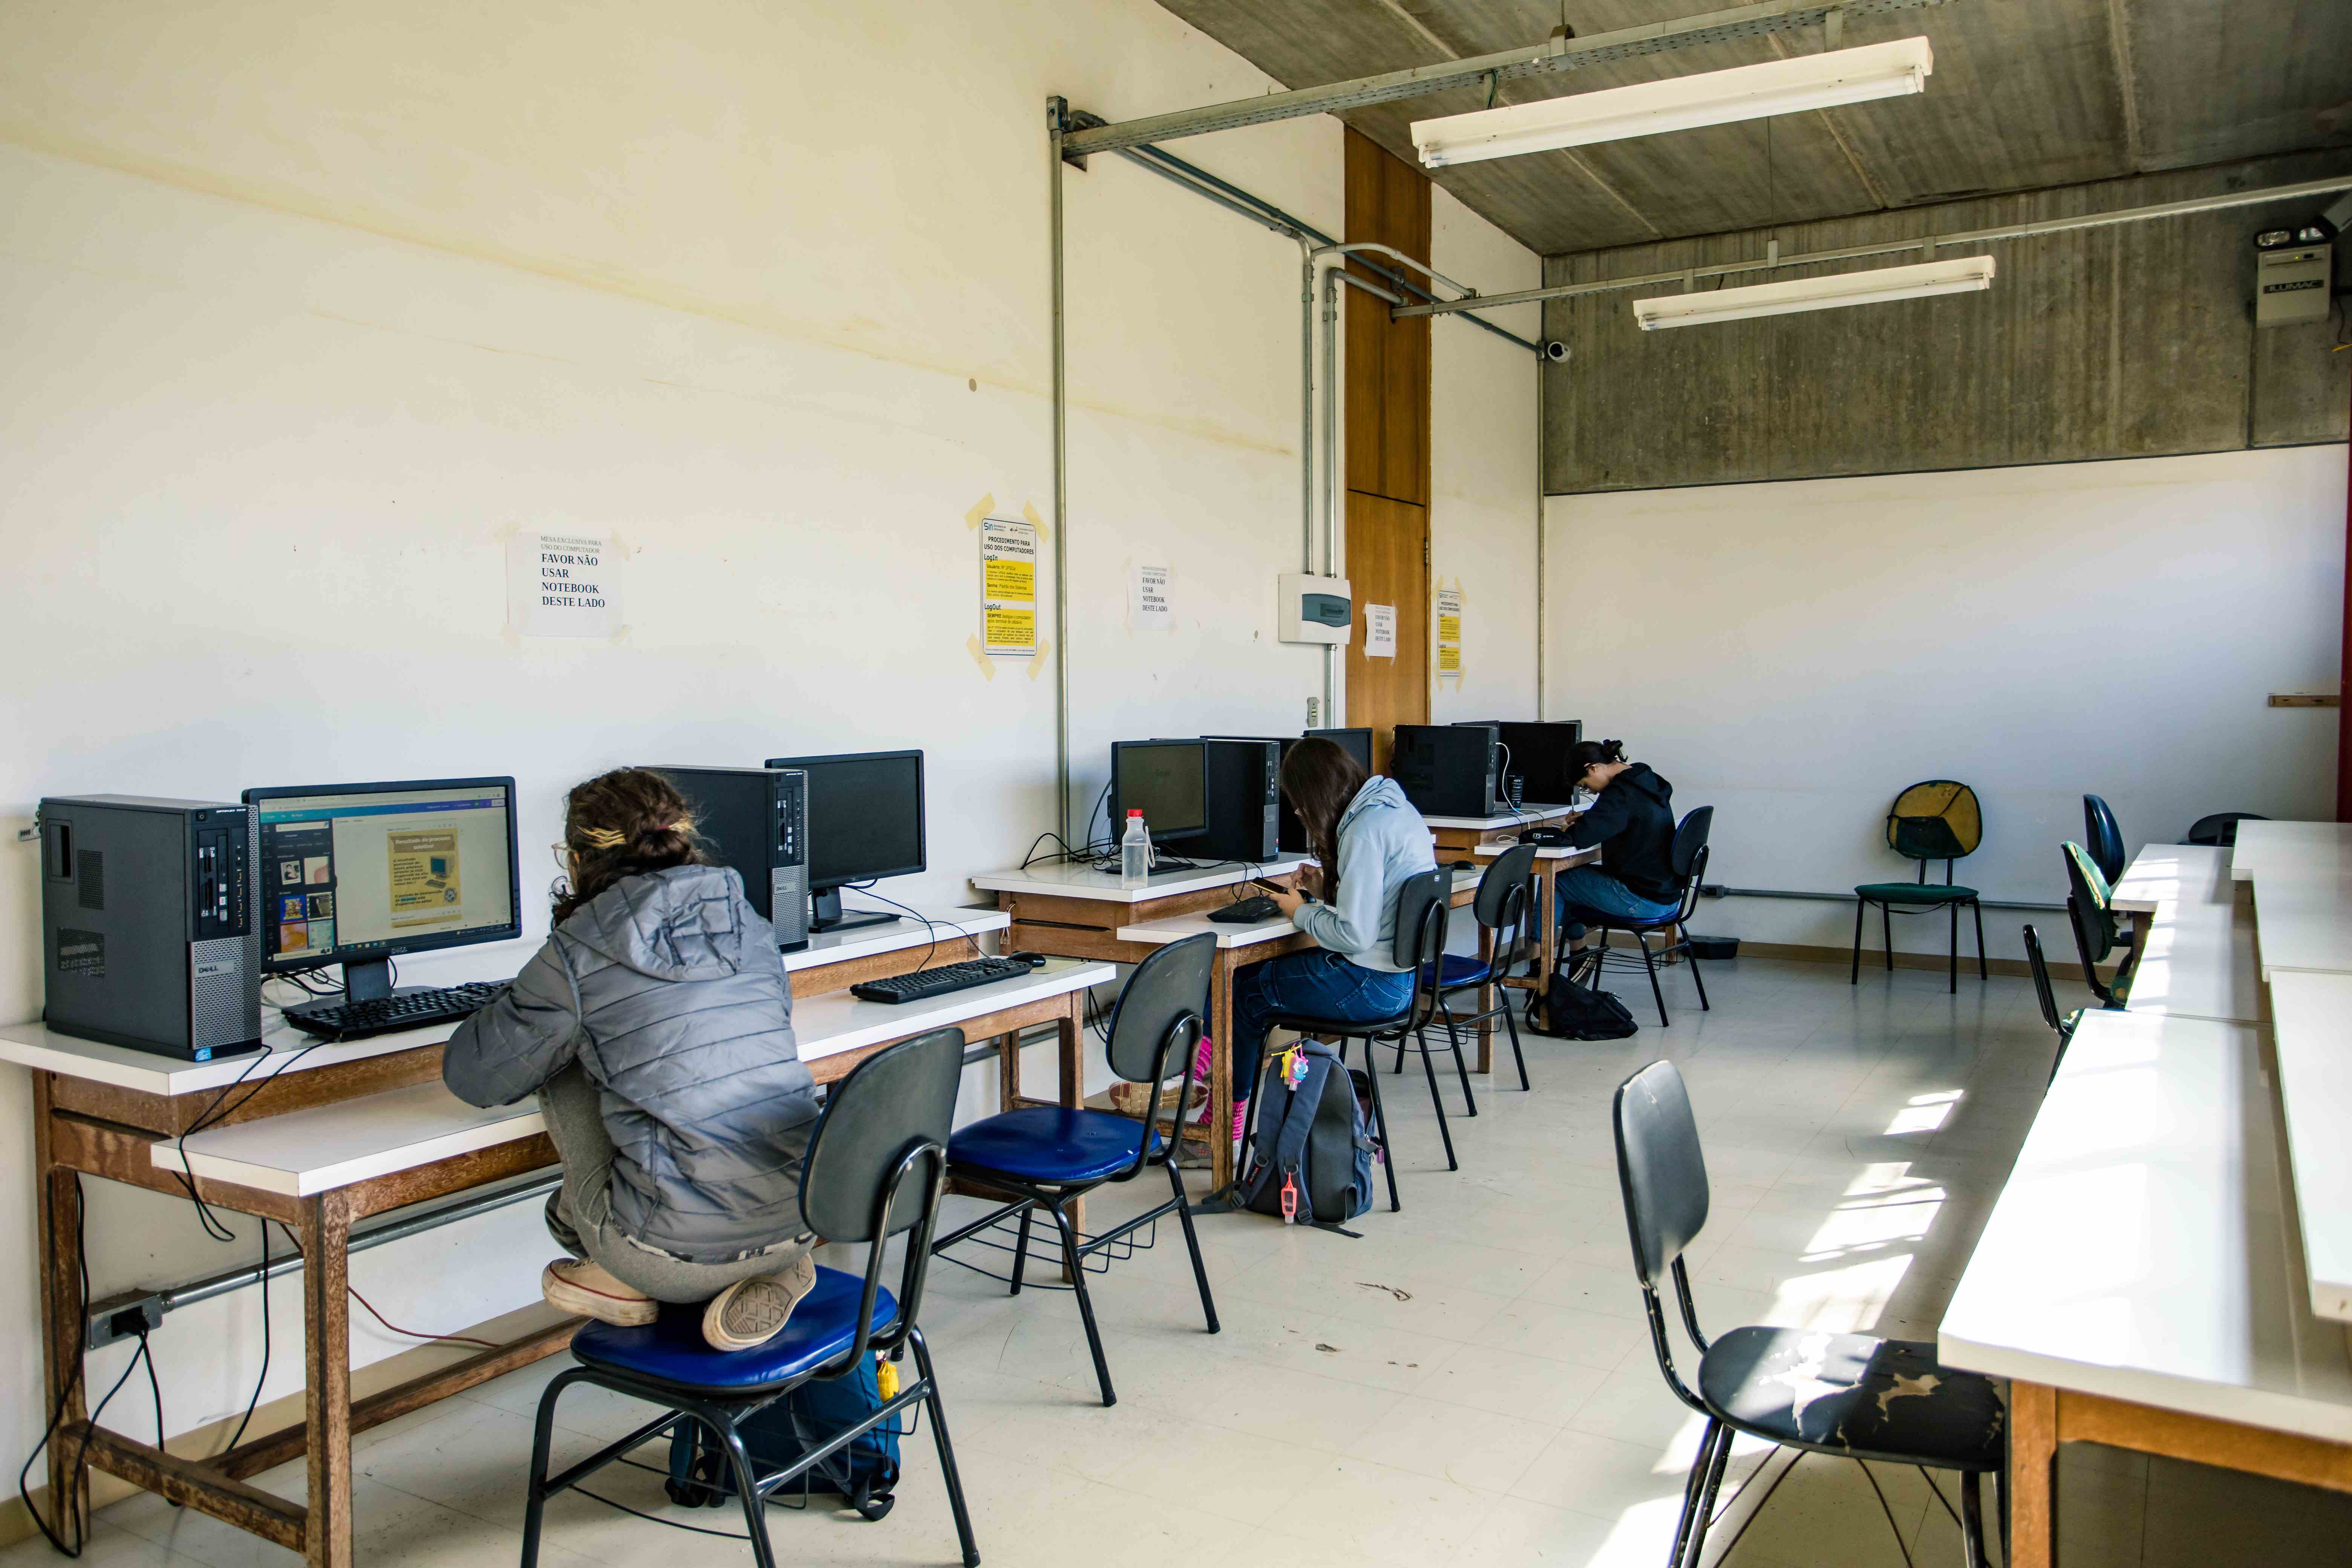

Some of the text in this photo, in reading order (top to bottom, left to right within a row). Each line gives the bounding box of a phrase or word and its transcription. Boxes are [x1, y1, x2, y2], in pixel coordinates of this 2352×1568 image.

[988, 536, 1020, 545] PROCEDIMENTO
[541, 553, 598, 566] FAVOR NÃO
[542, 568, 570, 578] USAR
[541, 582, 600, 594] NOTEBOOK
[542, 596, 605, 608] DESTE LADO
[199, 965, 218, 973] DELL
